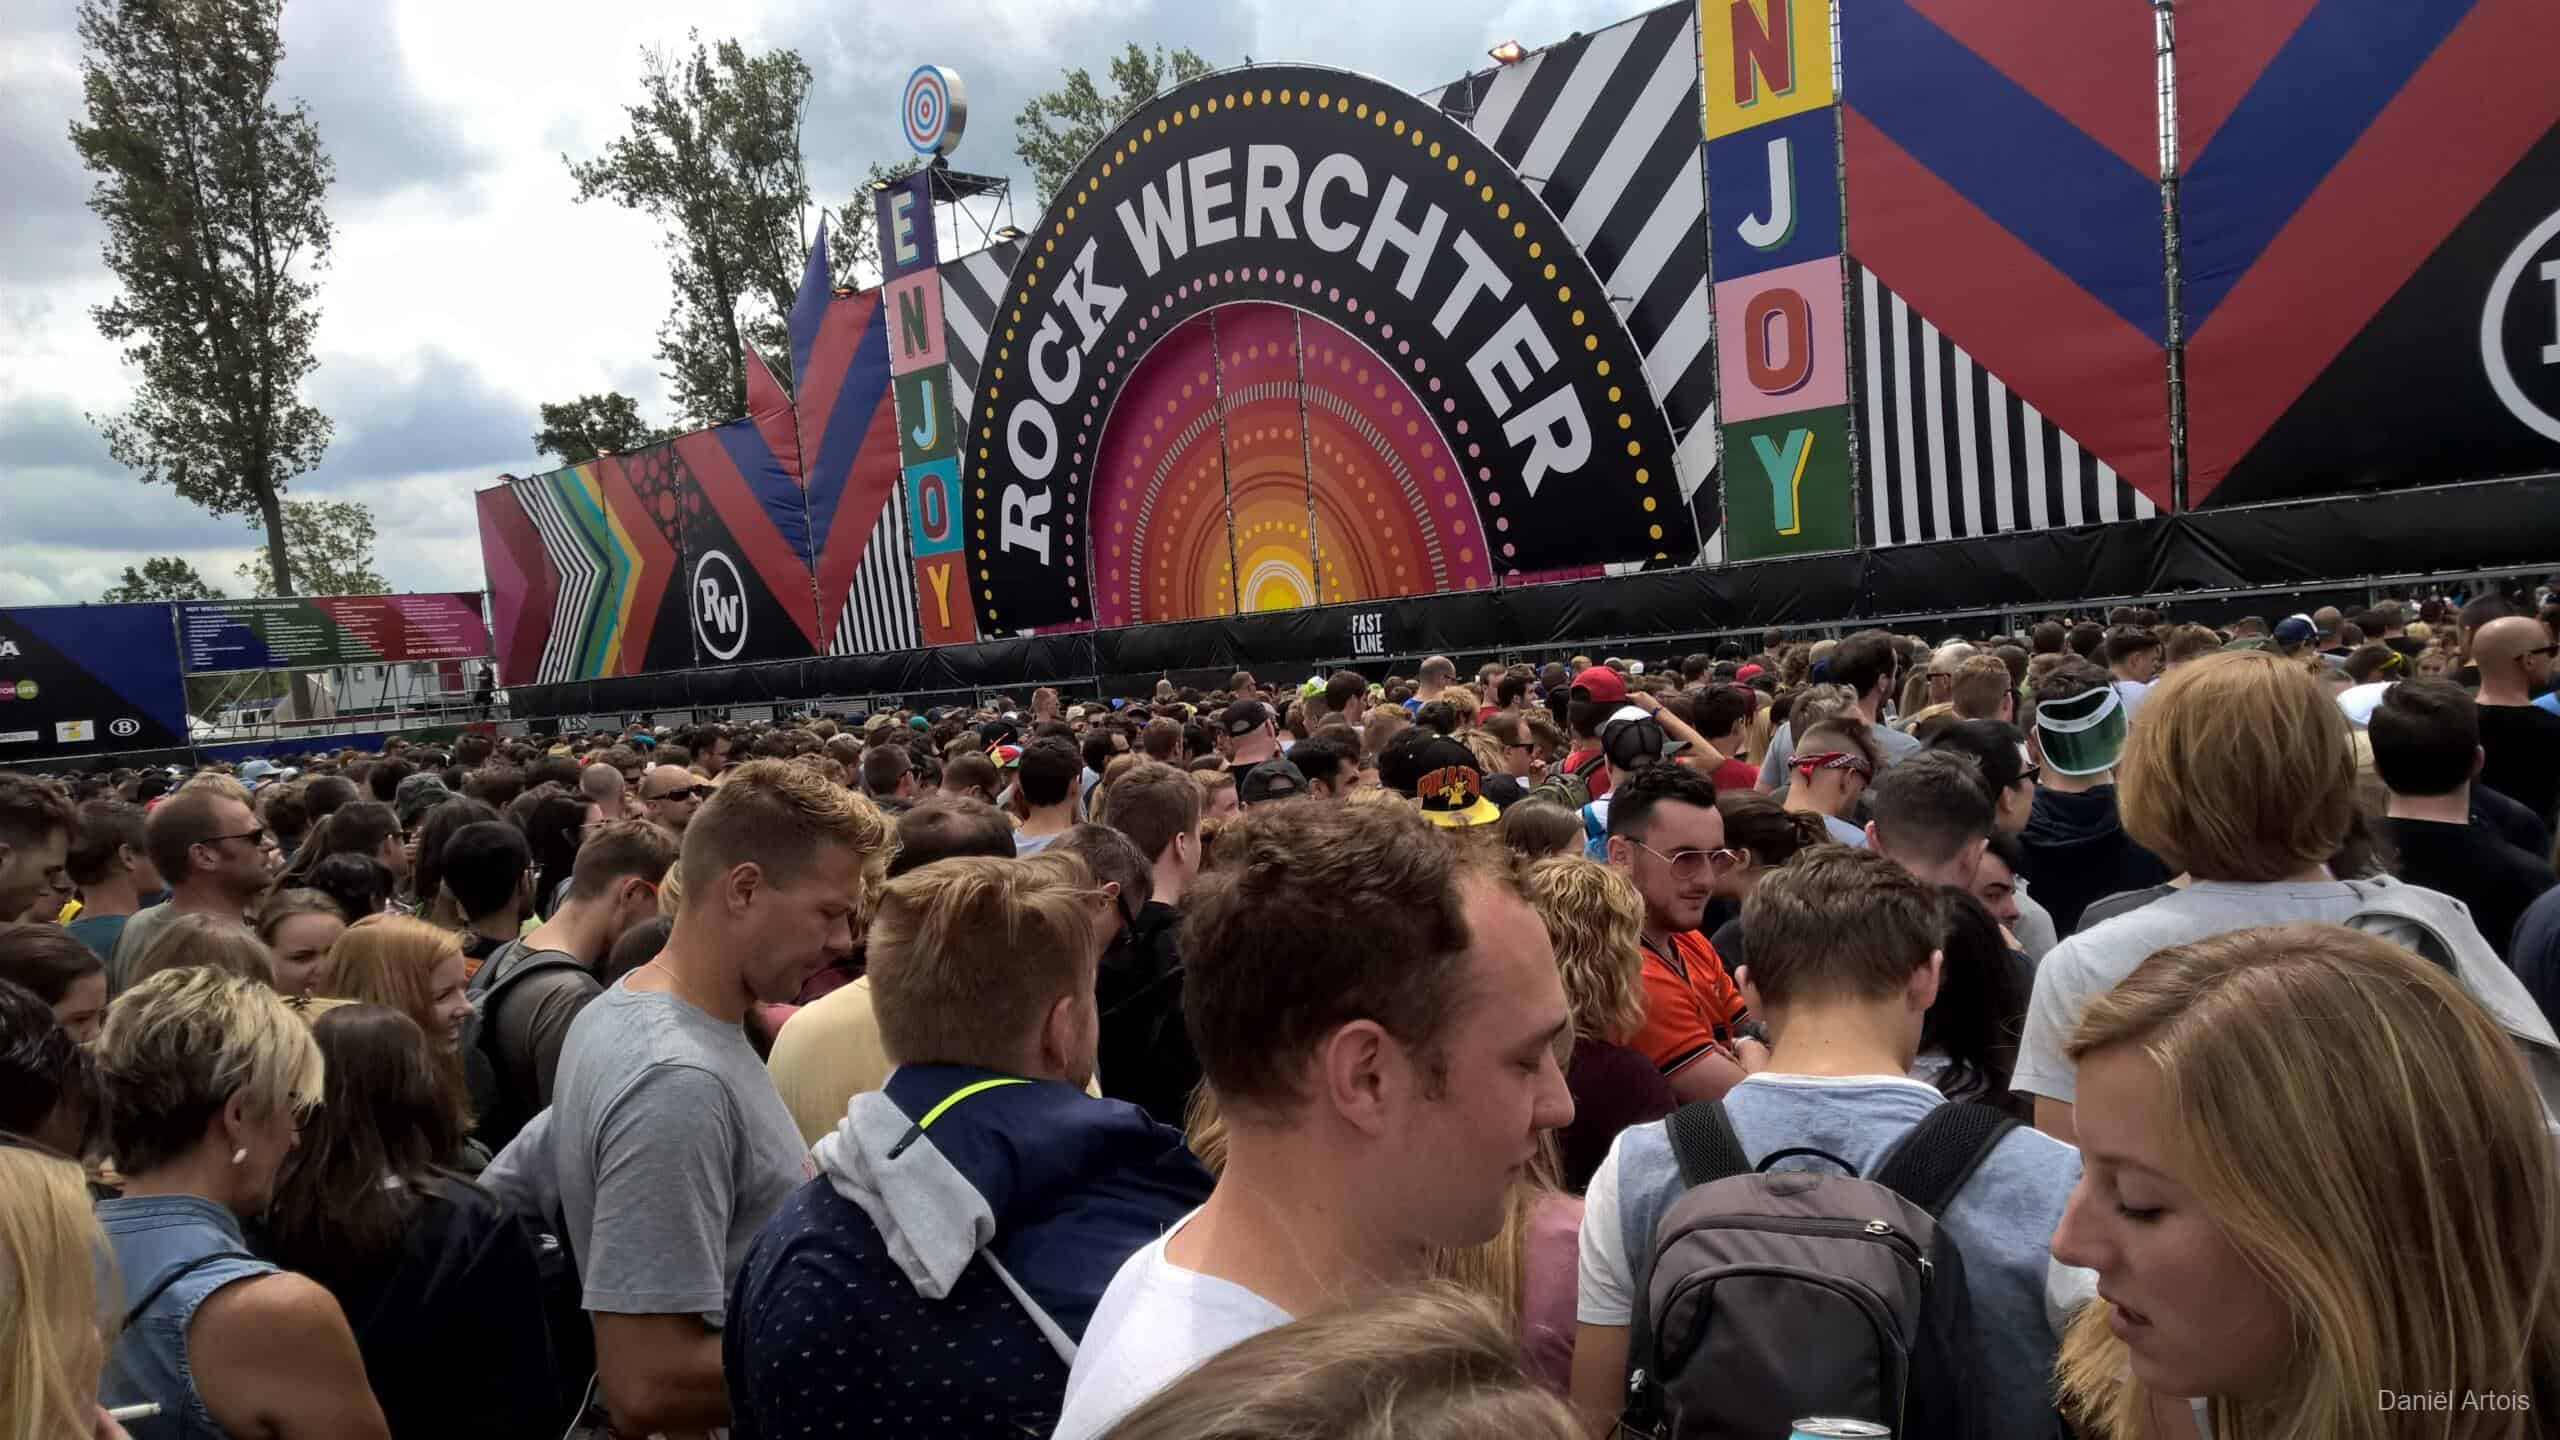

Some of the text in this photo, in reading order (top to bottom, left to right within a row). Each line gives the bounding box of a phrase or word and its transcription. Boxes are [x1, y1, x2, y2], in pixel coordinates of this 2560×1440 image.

[890, 191, 953, 628] ENJOY
[1000, 143, 1593, 567] ROCK WERCHTER
[699, 577, 740, 635] RW
[1352, 613, 1385, 654] FAST LANE
